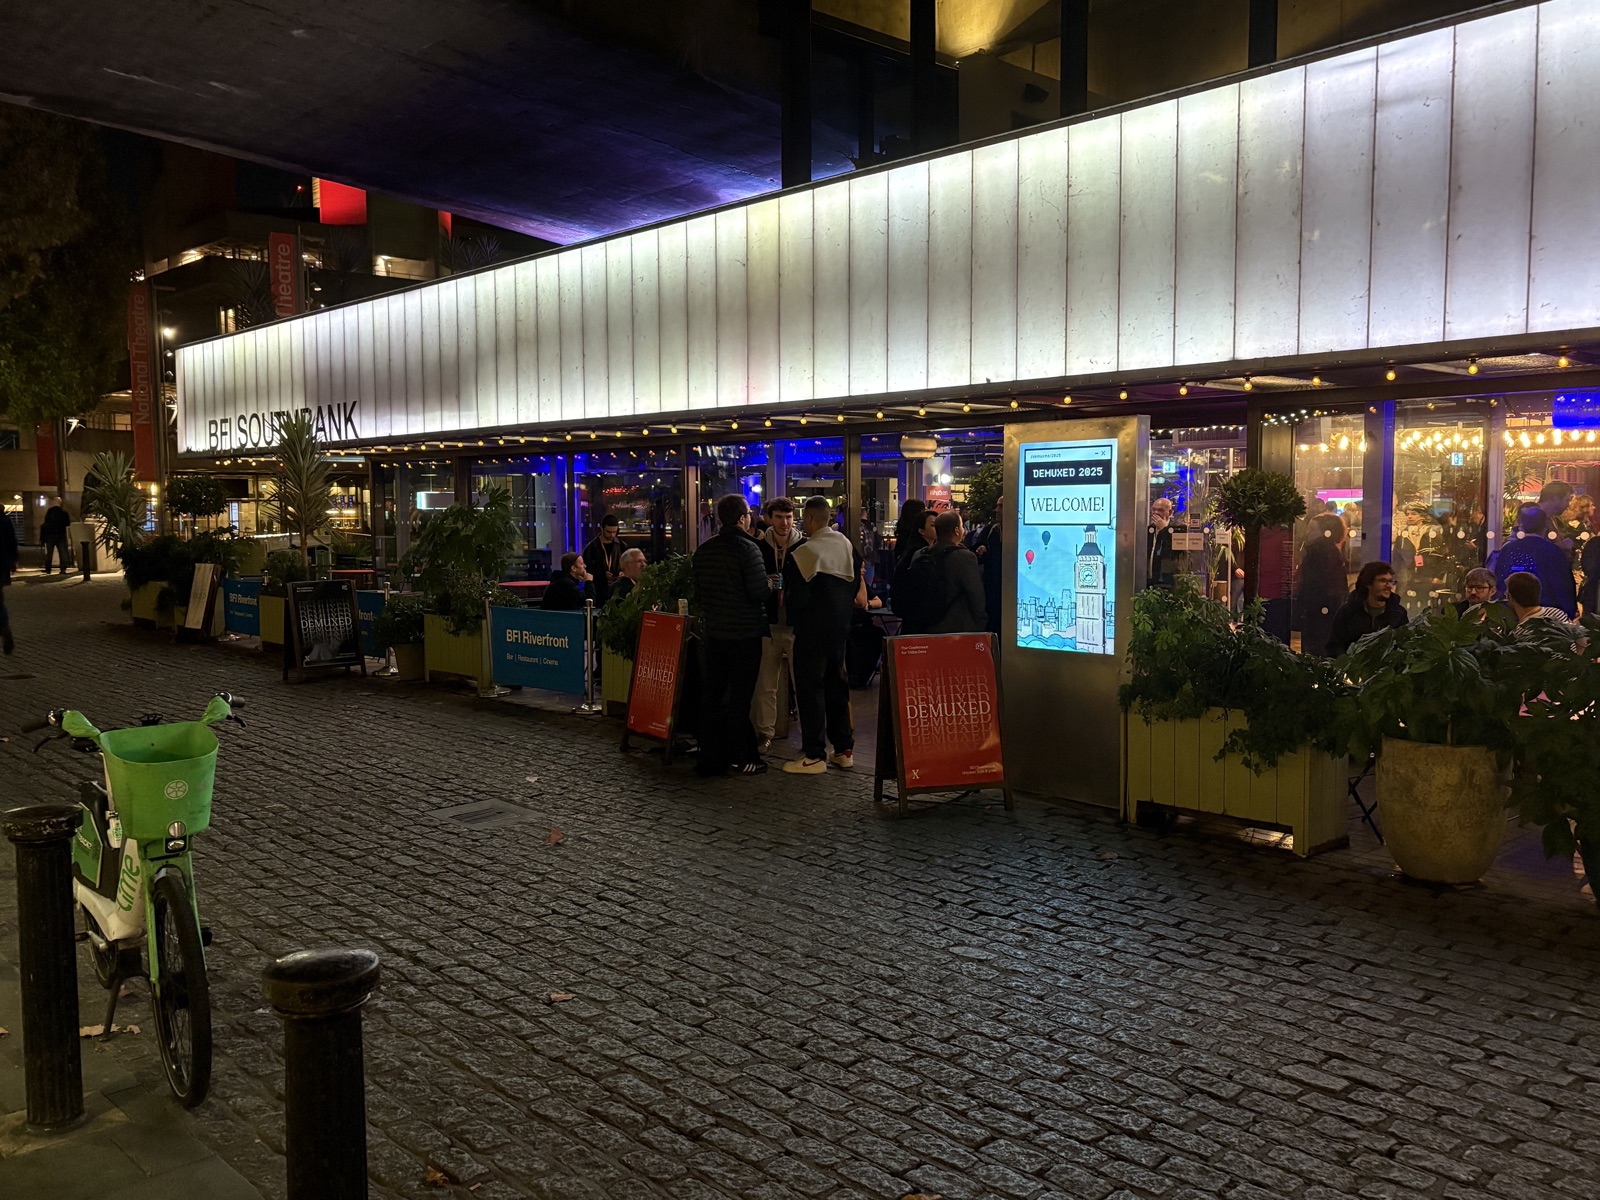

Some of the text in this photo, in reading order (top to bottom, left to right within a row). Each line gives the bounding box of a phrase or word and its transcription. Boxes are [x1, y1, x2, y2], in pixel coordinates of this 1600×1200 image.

[132, 294, 151, 425] National Theatre
[208, 417, 232, 450] BFI
[1032, 467, 1103, 478] DEMUXED 2025
[1030, 496, 1105, 512] WELCOME!
[301, 617, 352, 629] DEMUXED
[358, 609, 374, 622] front
[506, 628, 569, 649] BFI Riverfront
[517, 654, 539, 663] Restaurant
[637, 665, 674, 683] DEMUXED
[906, 700, 991, 719] DEMUXED
[912, 769, 920, 779] X
